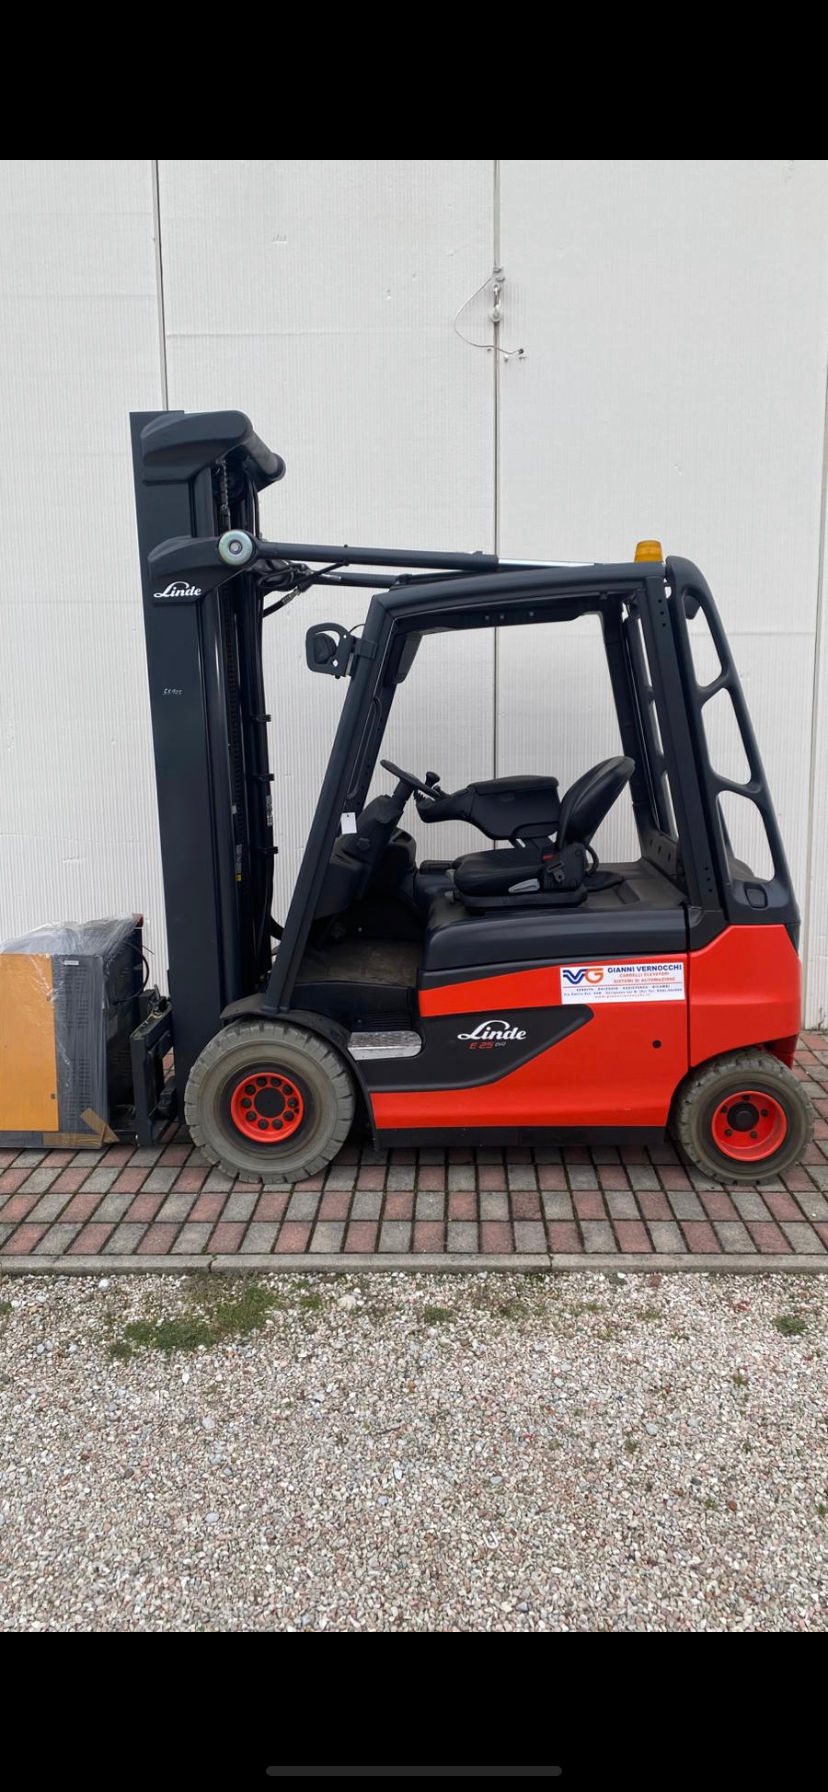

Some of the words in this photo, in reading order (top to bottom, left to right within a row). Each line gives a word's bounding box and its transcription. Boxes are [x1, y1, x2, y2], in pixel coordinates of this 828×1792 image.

[153, 581, 202, 598] Linde
[562, 968, 604, 984] VG
[636, 964, 682, 972] VERNOCCHI
[457, 1020, 527, 1040] Linde
[469, 1041, 478, 1049] E
[479, 1041, 495, 1049] 25
